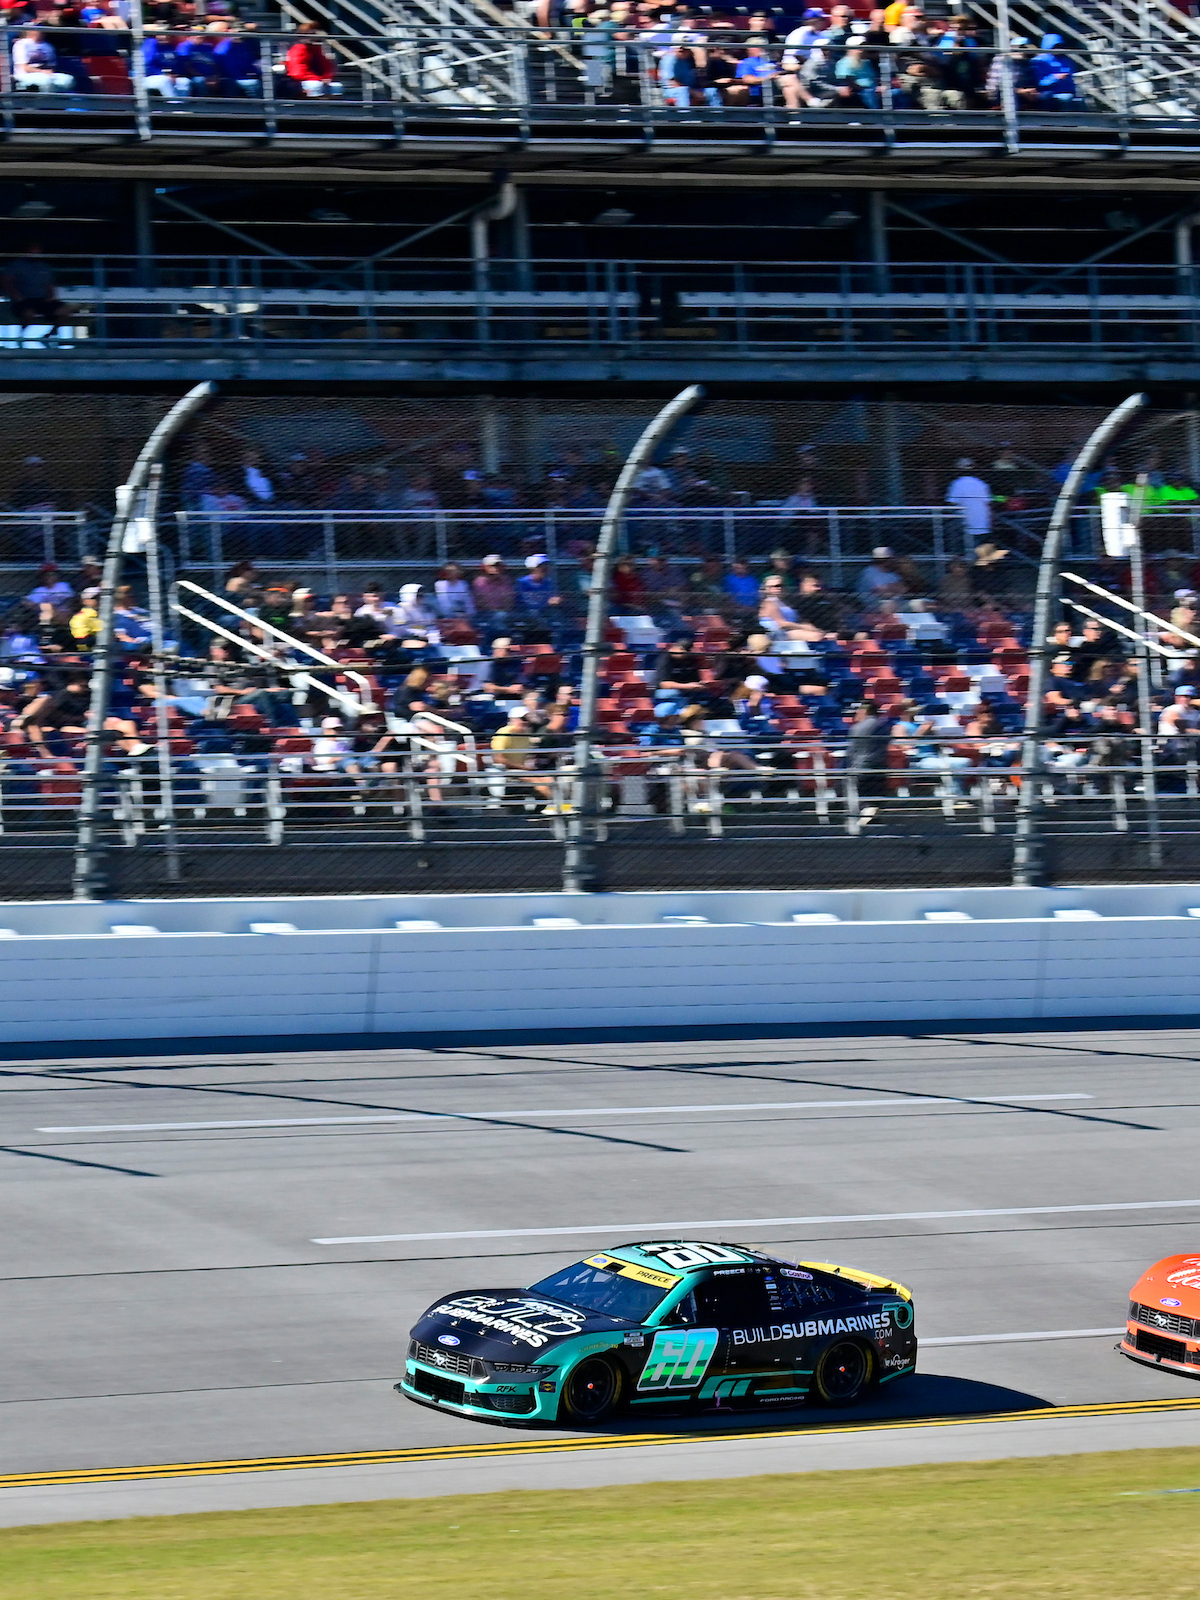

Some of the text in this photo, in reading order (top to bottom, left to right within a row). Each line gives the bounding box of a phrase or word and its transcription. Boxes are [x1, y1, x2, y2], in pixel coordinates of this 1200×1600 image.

[636, 1270, 672, 1284] PREECE
[431, 1304, 549, 1348] SUBMARINES
[448, 1295, 583, 1336] BUILD
[733, 1312, 892, 1346] BUILDSUBMARINES
[874, 1328, 893, 1340] .COM
[636, 1328, 719, 1391] 60
[890, 1353, 911, 1371] Kroger
[496, 1385, 517, 1393] RFK
